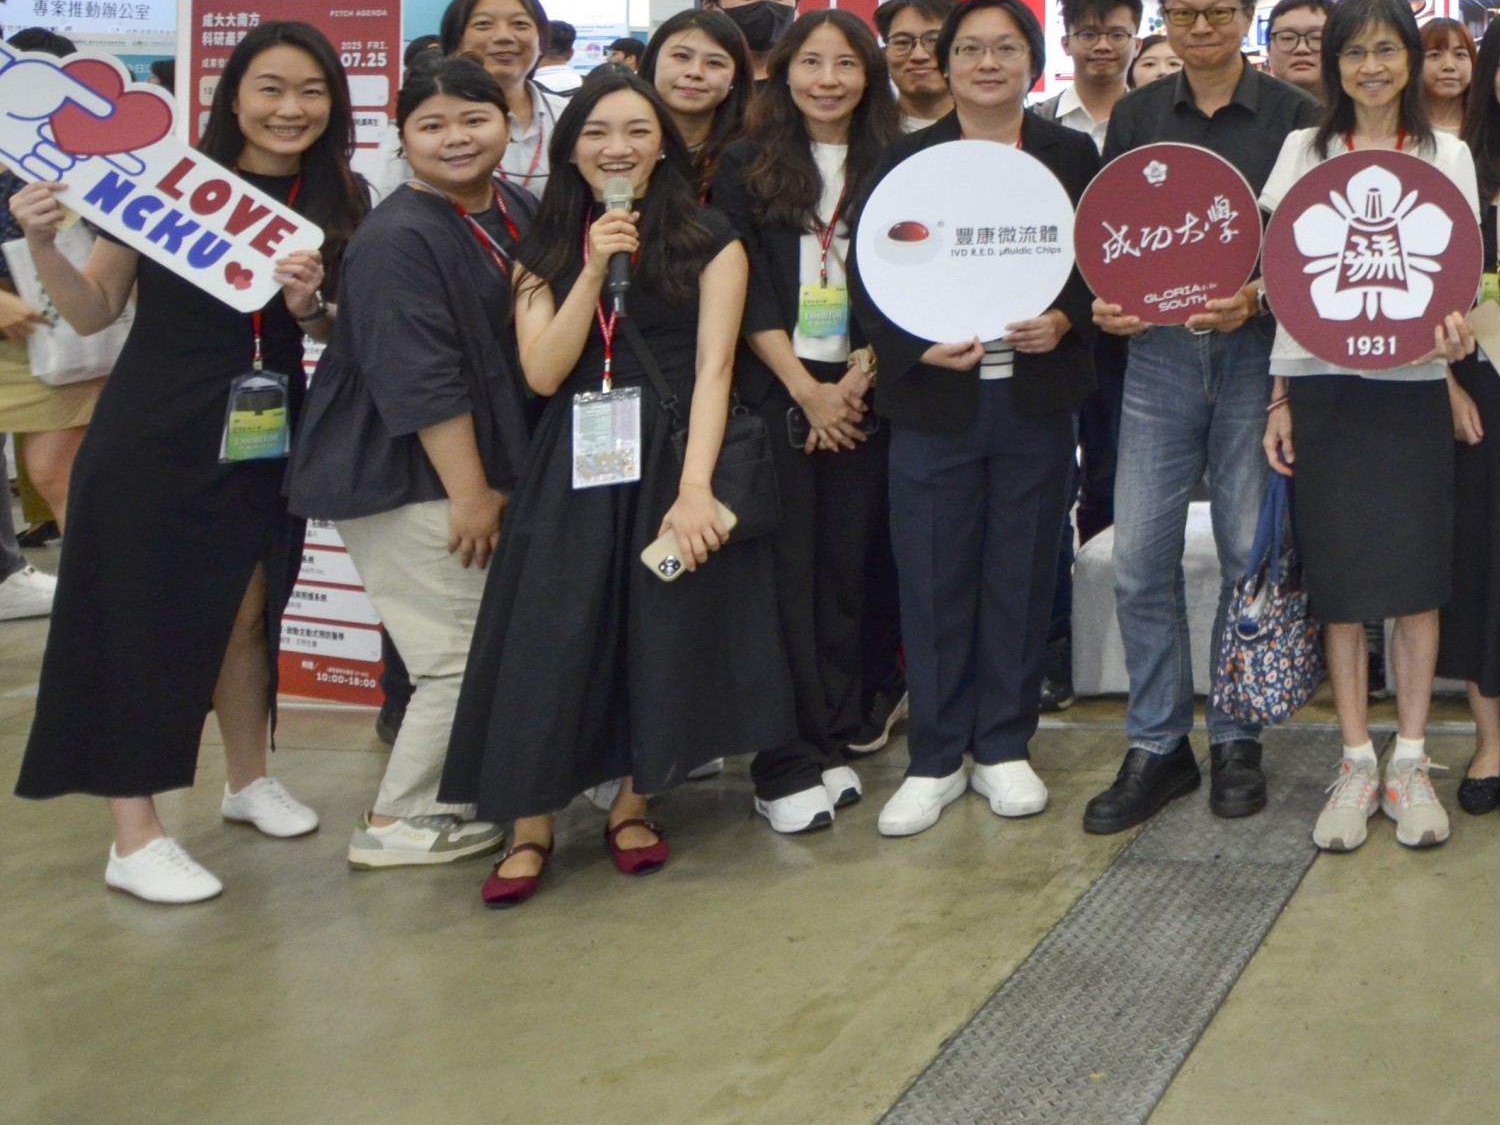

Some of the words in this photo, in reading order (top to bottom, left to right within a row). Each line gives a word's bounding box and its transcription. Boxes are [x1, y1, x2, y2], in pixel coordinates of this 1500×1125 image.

[202, 12, 260, 27] 成大大南方
[355, 9, 388, 17] AGENDA
[341, 41, 362, 50] 2025
[367, 41, 389, 49] FRI.
[341, 52, 387, 67] 07.25
[155, 157, 298, 258] LOVE
[82, 170, 233, 269] NCKU
[954, 224, 1060, 245] 豐康微流體
[1102, 194, 1239, 264] 成功大學
[950, 249, 968, 258] IVD
[1035, 245, 1062, 256] Chips
[1144, 283, 1201, 304] GLORIA
[1158, 294, 1207, 312] SOUTH
[1346, 336, 1397, 356] 1931
[317, 672, 377, 688] 10:00-18:00
